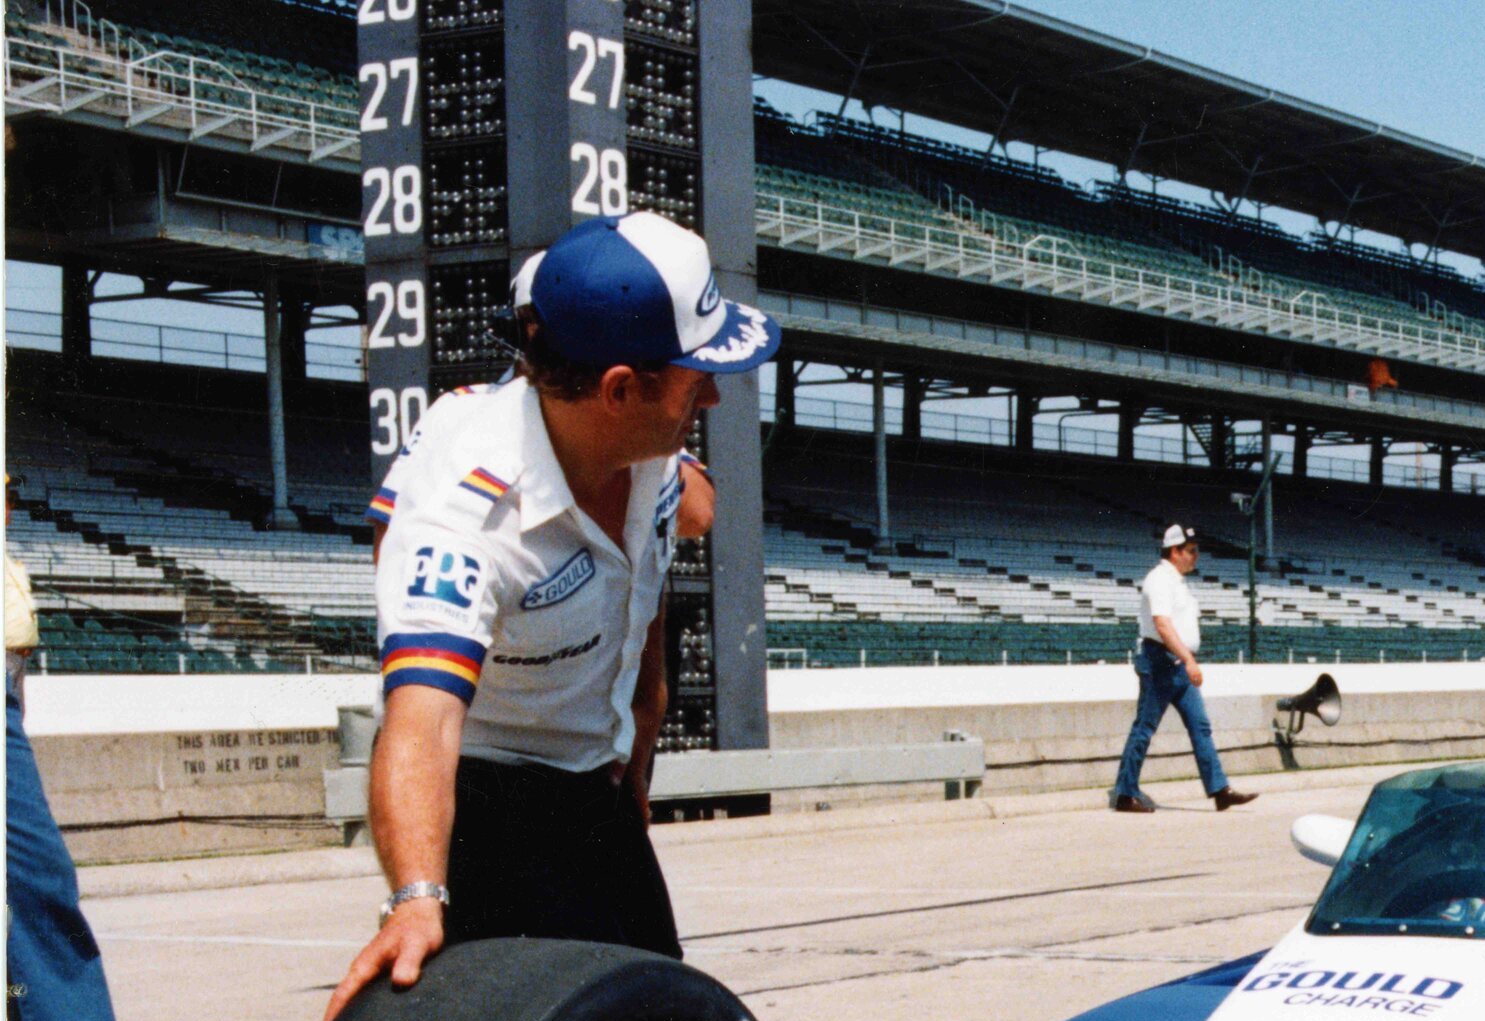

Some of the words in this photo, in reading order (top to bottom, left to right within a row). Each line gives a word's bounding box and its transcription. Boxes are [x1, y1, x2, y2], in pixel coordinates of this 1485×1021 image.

[359, 57, 418, 132] 27
[568, 30, 624, 109] 27
[363, 165, 422, 236] 28
[571, 142, 628, 216] 28
[367, 280, 426, 348] 29
[370, 387, 428, 455] 30
[545, 555, 592, 601] GOULD
[1242, 970, 1465, 1001] GOULD
[1283, 991, 1442, 1018] CHARGE
